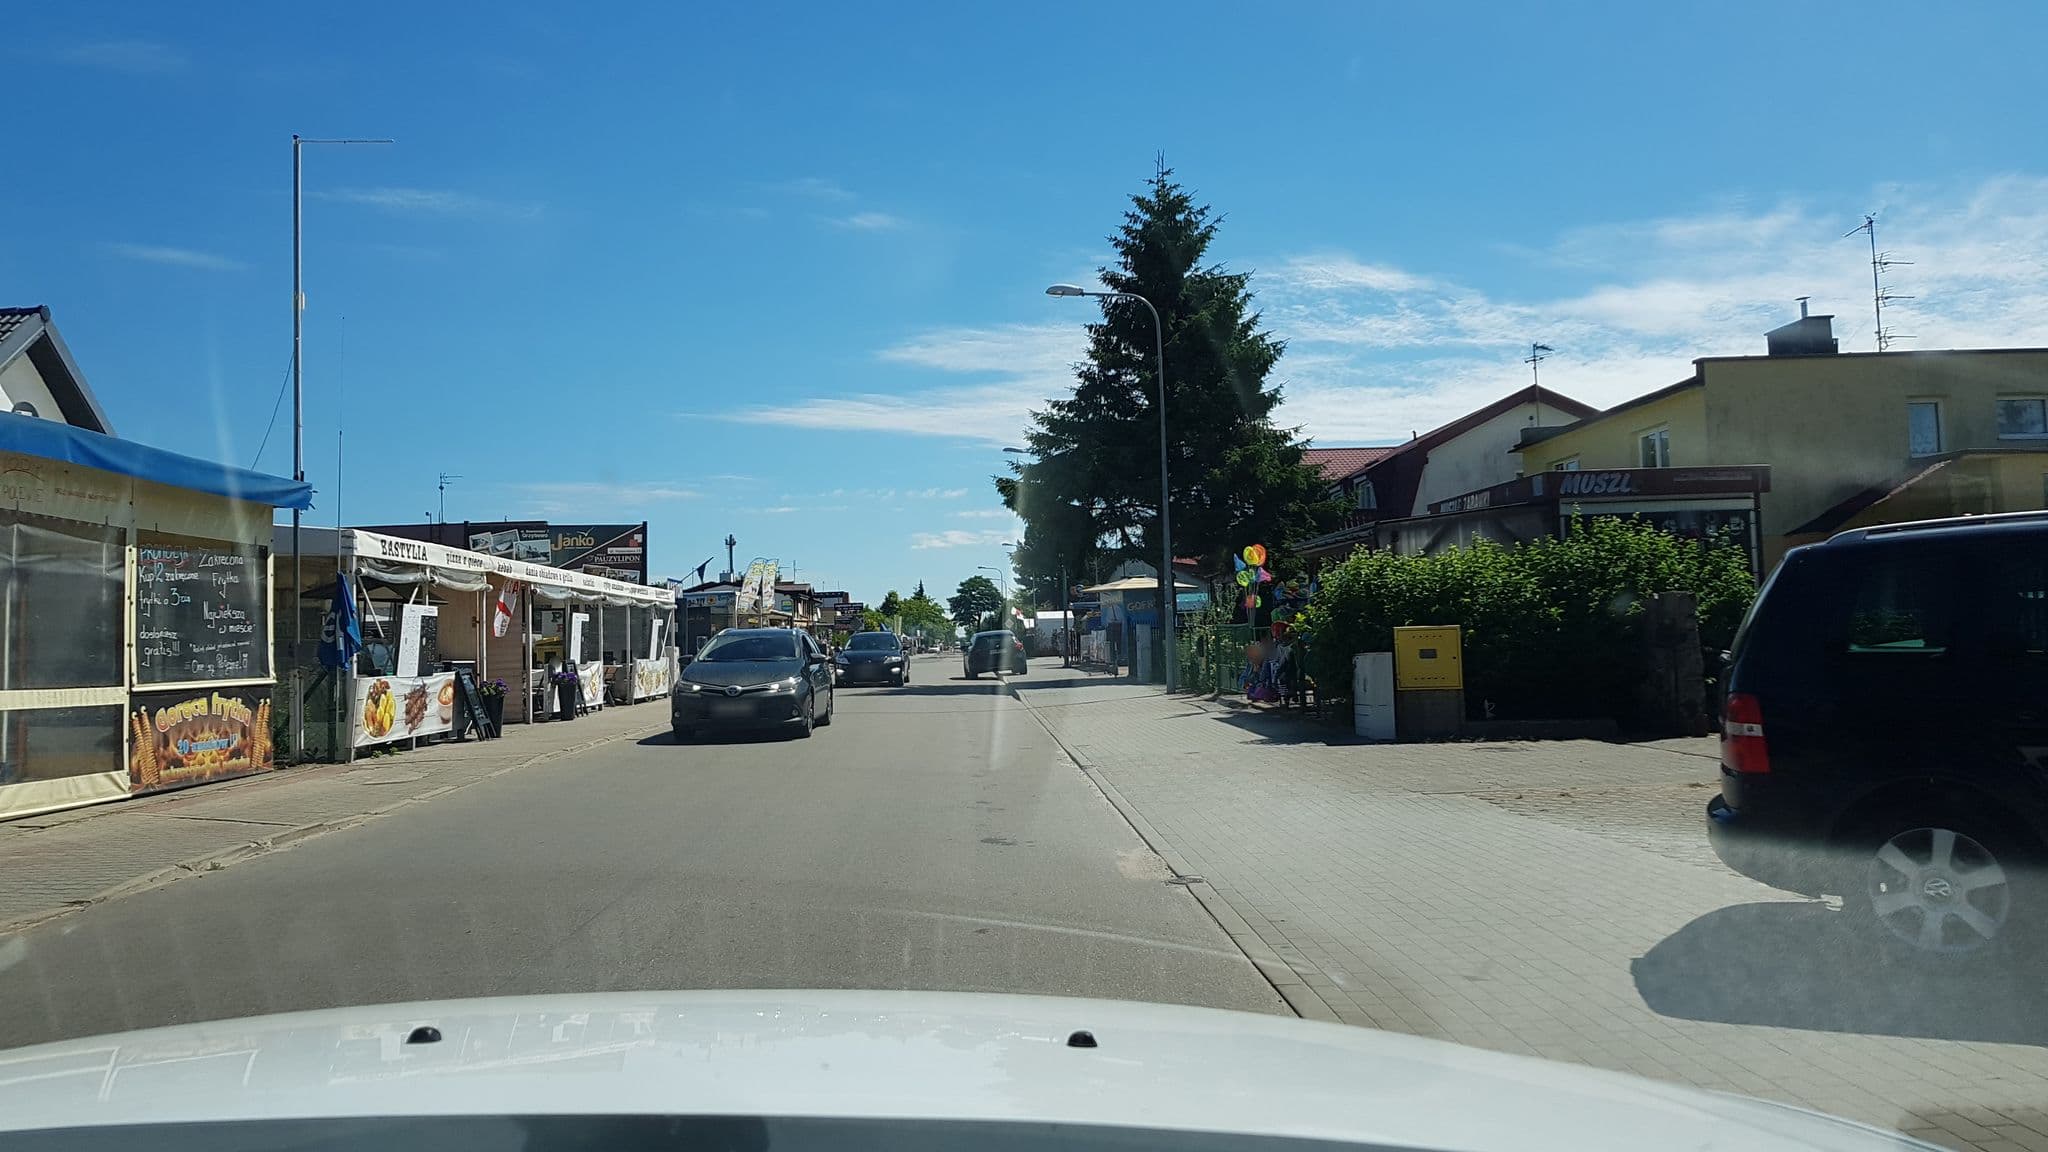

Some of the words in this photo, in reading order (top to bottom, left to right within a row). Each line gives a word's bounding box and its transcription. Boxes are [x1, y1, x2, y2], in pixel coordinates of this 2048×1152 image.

[380, 539, 428, 561] BASTYLIA
[551, 533, 595, 551] Janko
[594, 555, 641, 564] PAUZYLIPON
